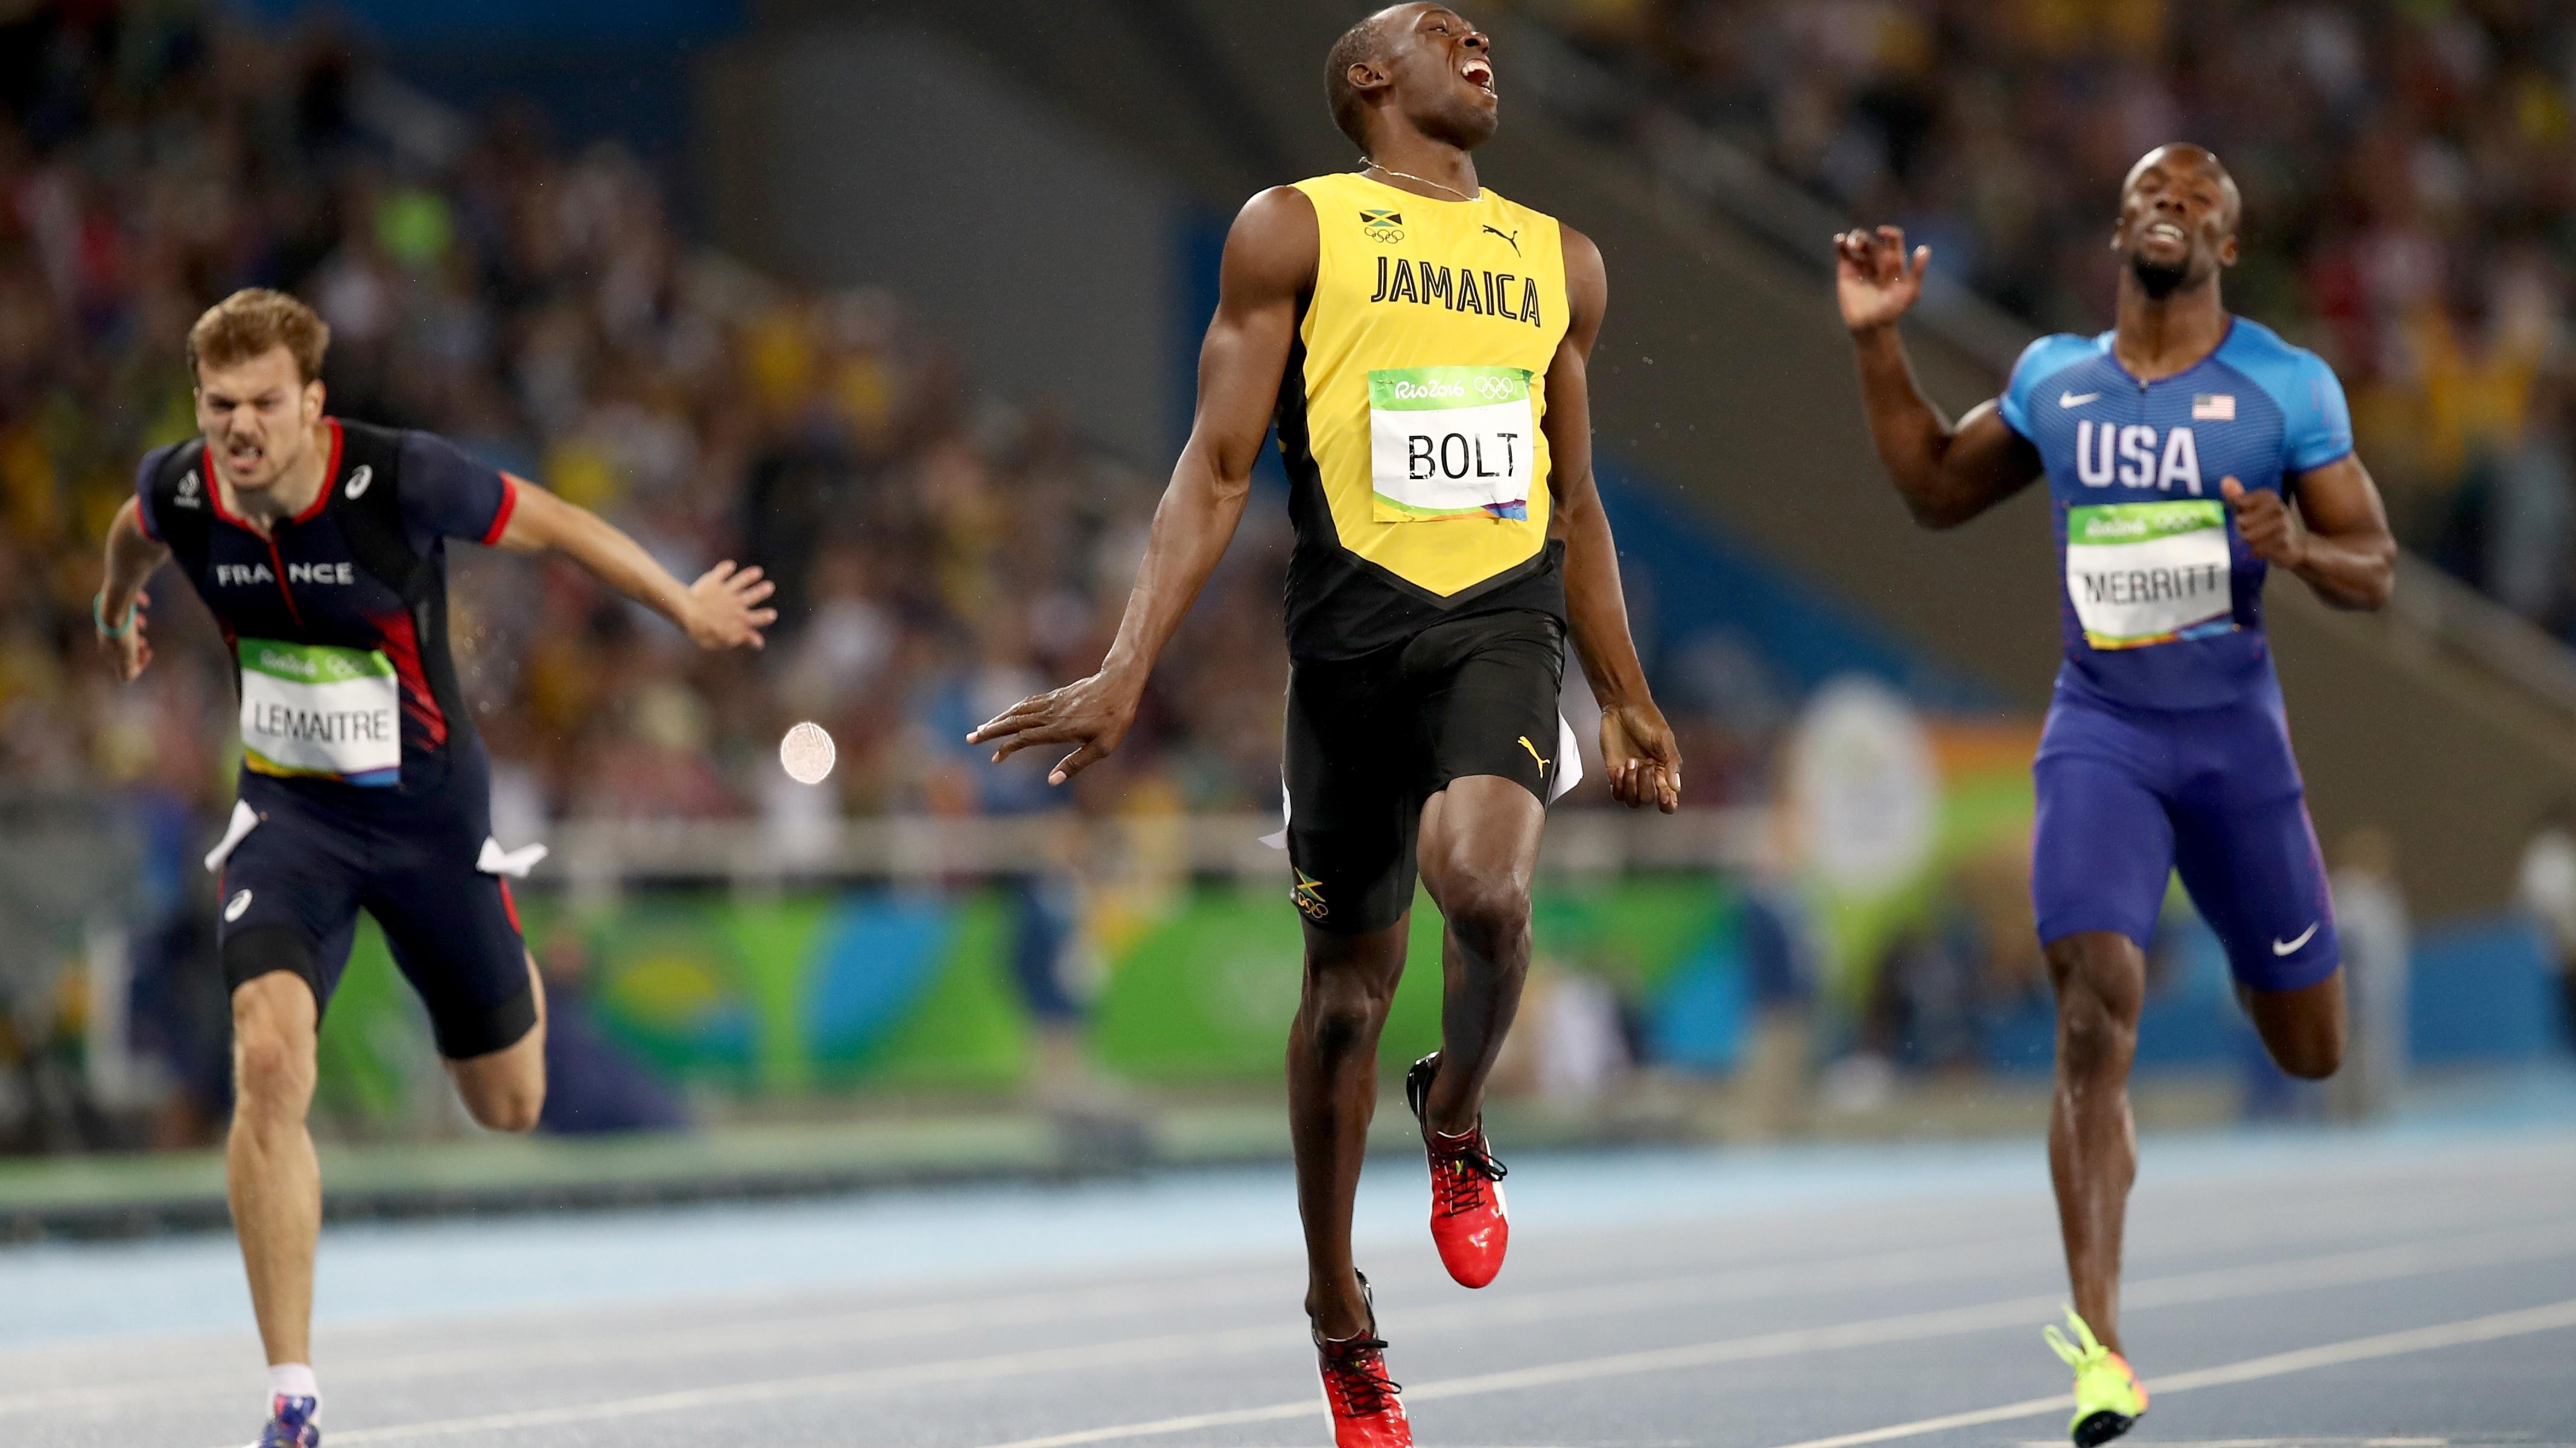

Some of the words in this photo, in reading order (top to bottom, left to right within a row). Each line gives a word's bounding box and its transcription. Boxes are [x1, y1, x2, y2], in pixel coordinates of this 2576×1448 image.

[1371, 256, 1541, 328] JAMAICA
[1409, 432, 1518, 480] BOLT
[2076, 420, 2203, 496] USA
[216, 562, 355, 587] FRANCE
[254, 700, 390, 743] LEMAITRE
